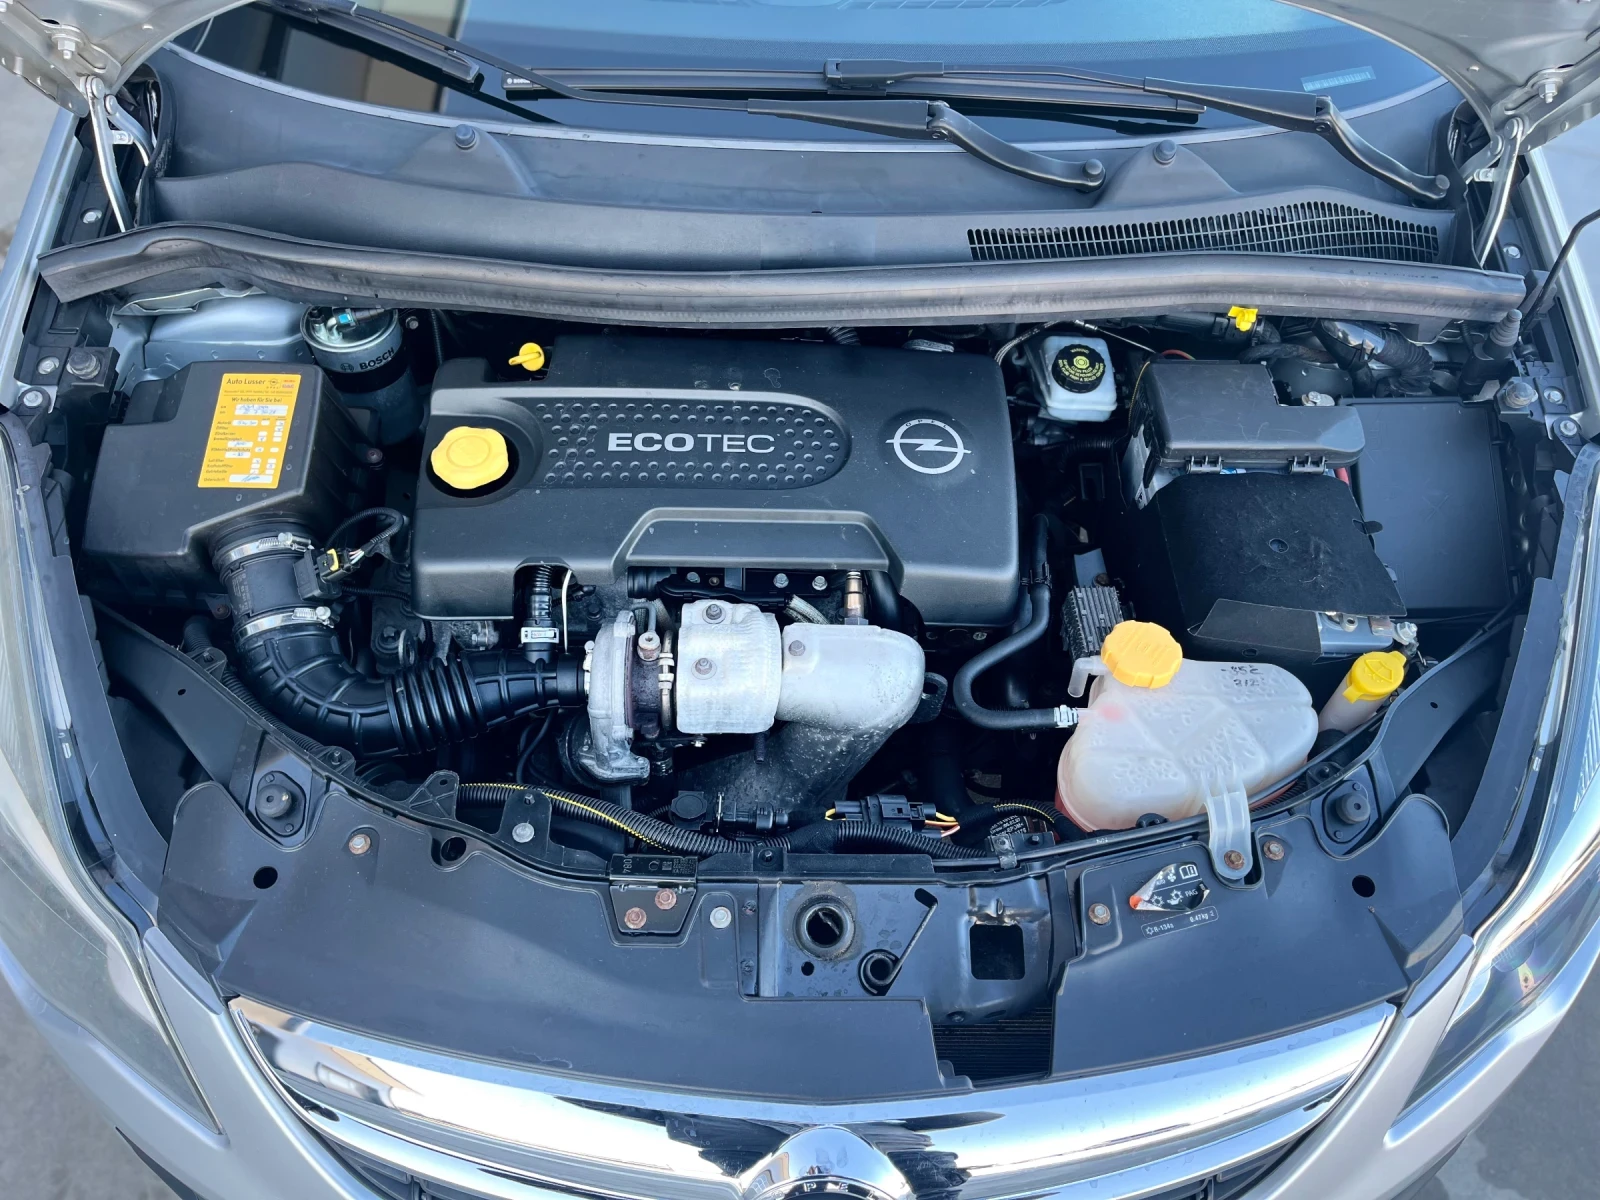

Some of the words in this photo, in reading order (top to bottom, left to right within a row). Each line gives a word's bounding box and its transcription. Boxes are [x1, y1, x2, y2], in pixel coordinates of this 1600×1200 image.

[359, 347, 395, 370] BOSCH
[607, 432, 776, 453] ECOTEC
[1184, 888, 1199, 897] PAG
